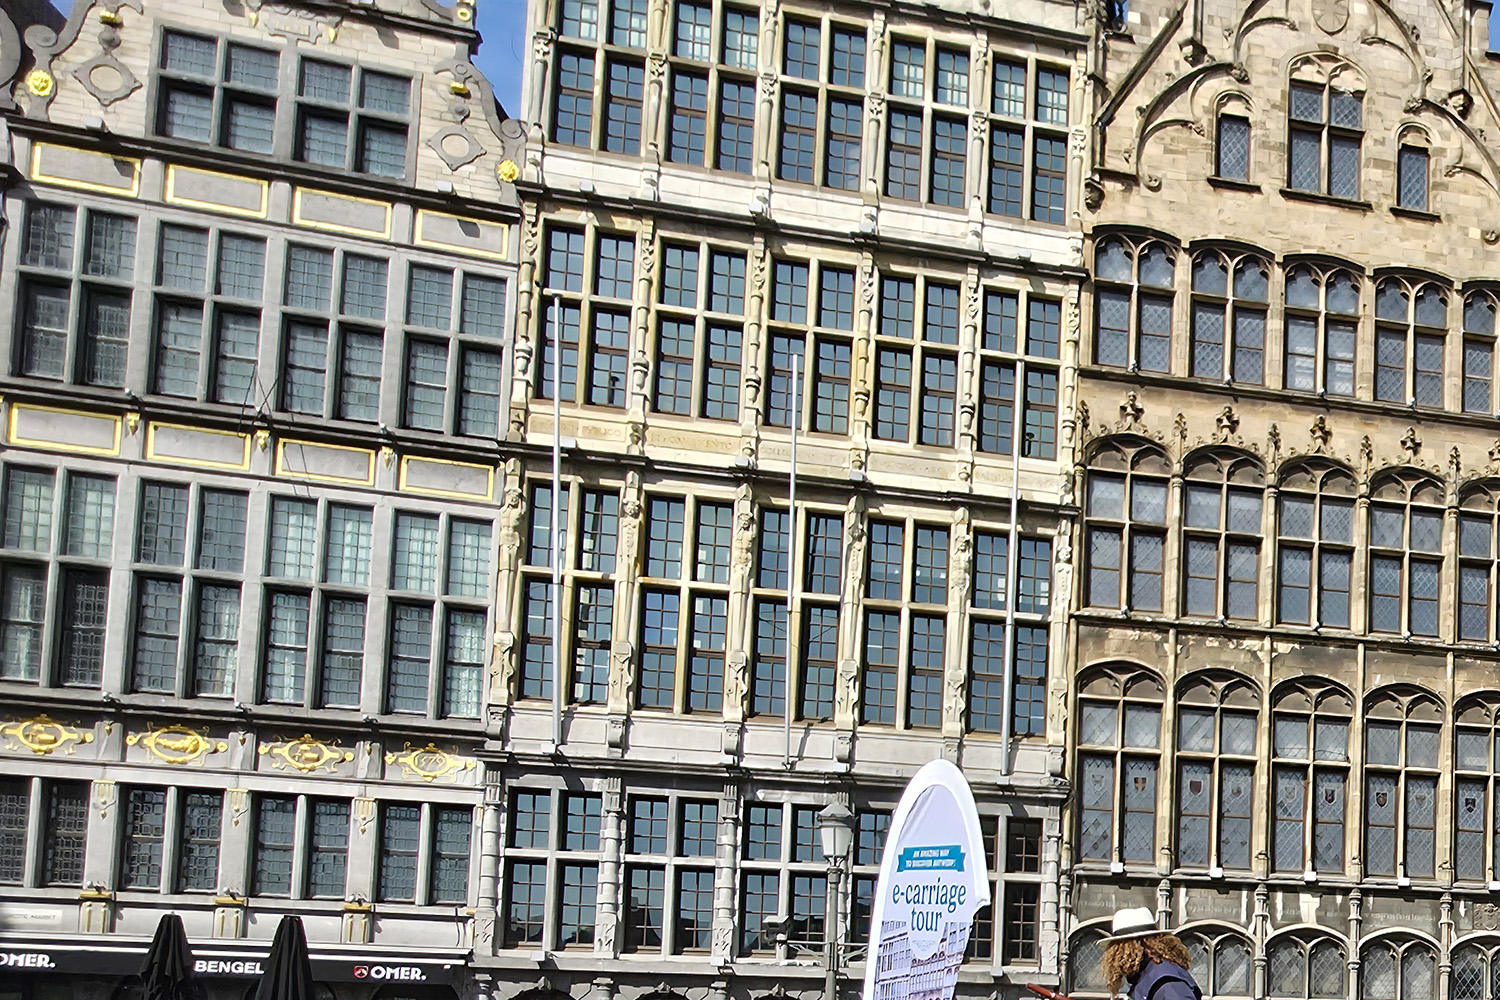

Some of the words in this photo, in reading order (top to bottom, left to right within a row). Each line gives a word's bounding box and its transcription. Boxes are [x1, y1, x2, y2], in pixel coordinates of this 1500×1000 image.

[892, 876, 967, 913] e-carriage
[910, 906, 943, 932] tour
[193, 959, 265, 975] BENGEL
[370, 965, 427, 980] OMER.
